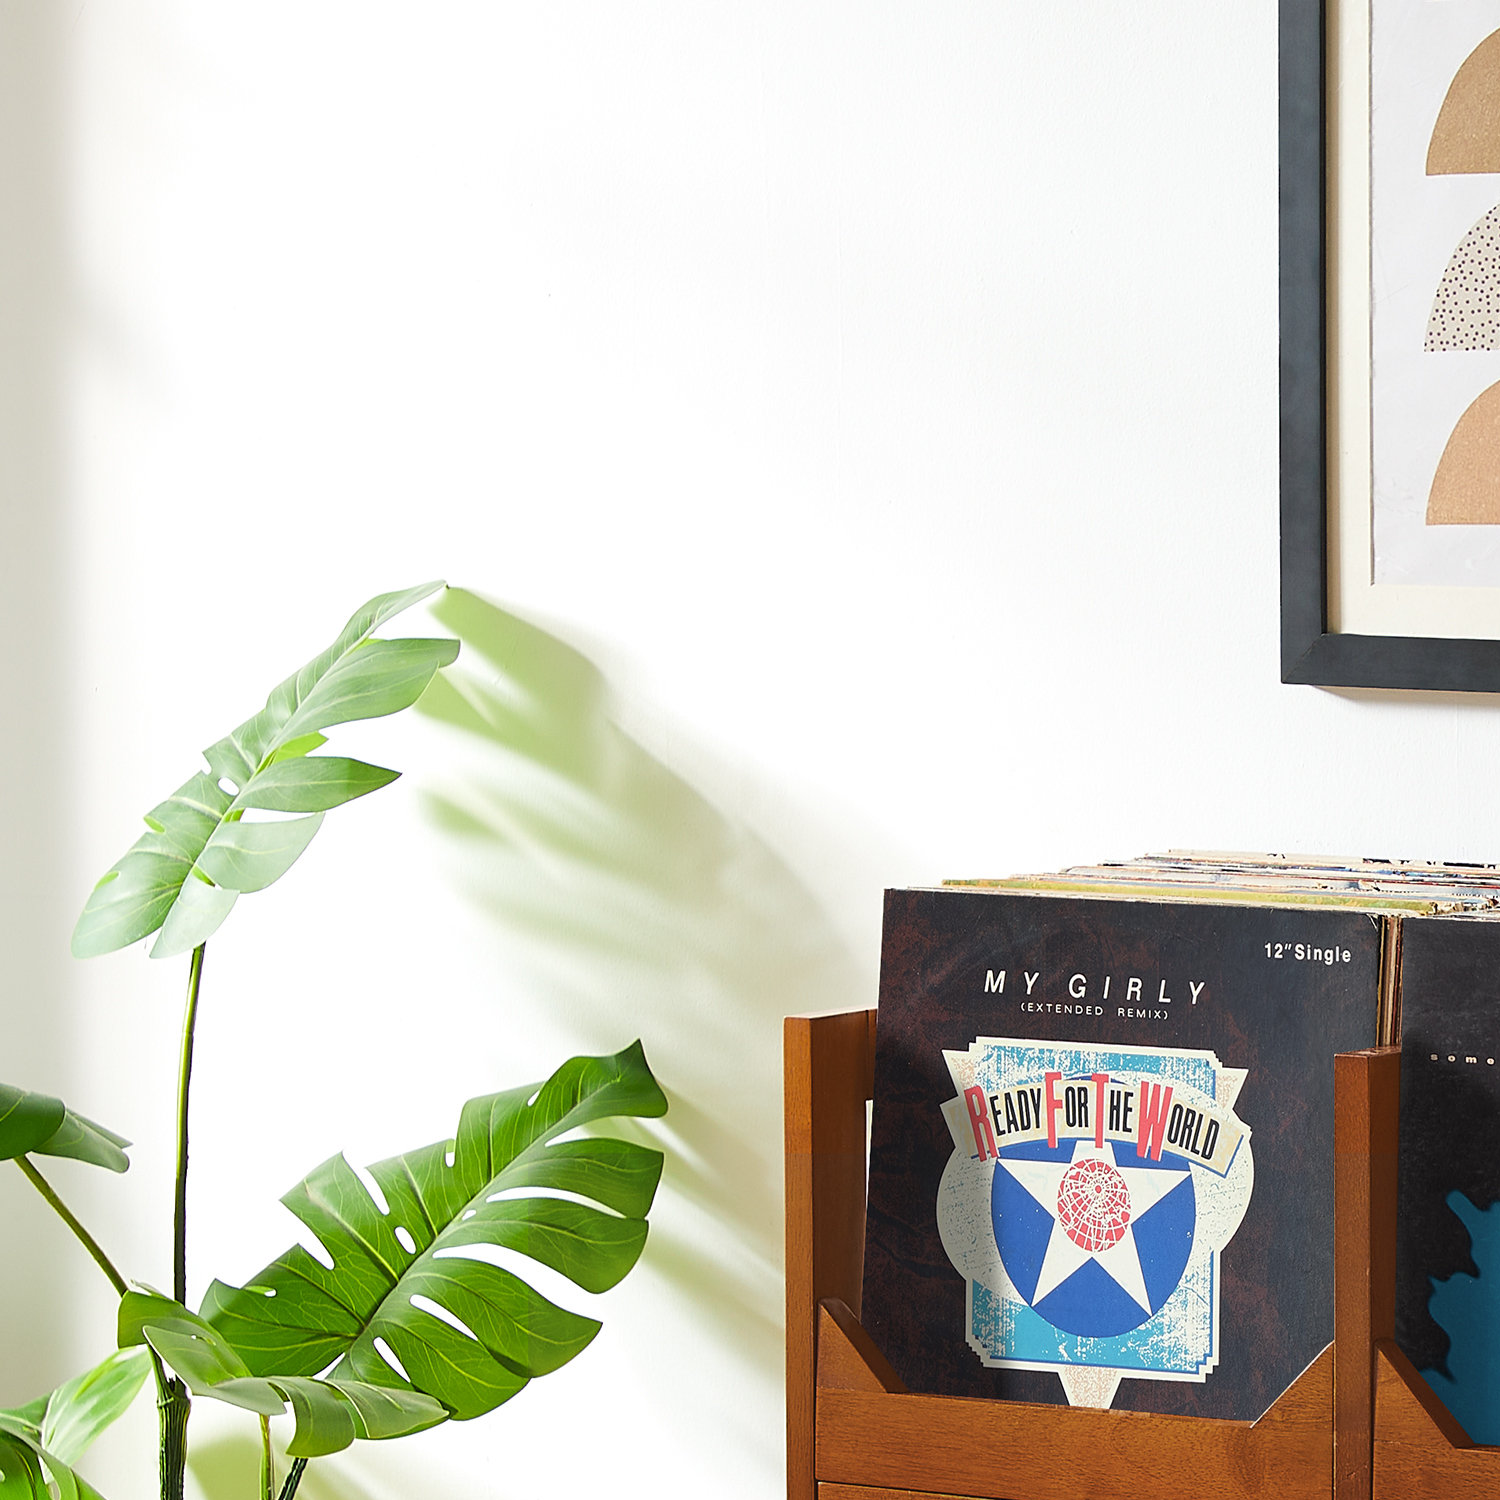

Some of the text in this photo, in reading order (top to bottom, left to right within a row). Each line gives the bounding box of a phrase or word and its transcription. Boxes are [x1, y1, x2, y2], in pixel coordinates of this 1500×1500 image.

[984, 970, 1205, 1005] MY GIRLY
[1020, 1002, 1169, 1020] (EXTENDED REMIX)
[964, 1072, 1220, 1162] READY FOR THE WORLD
